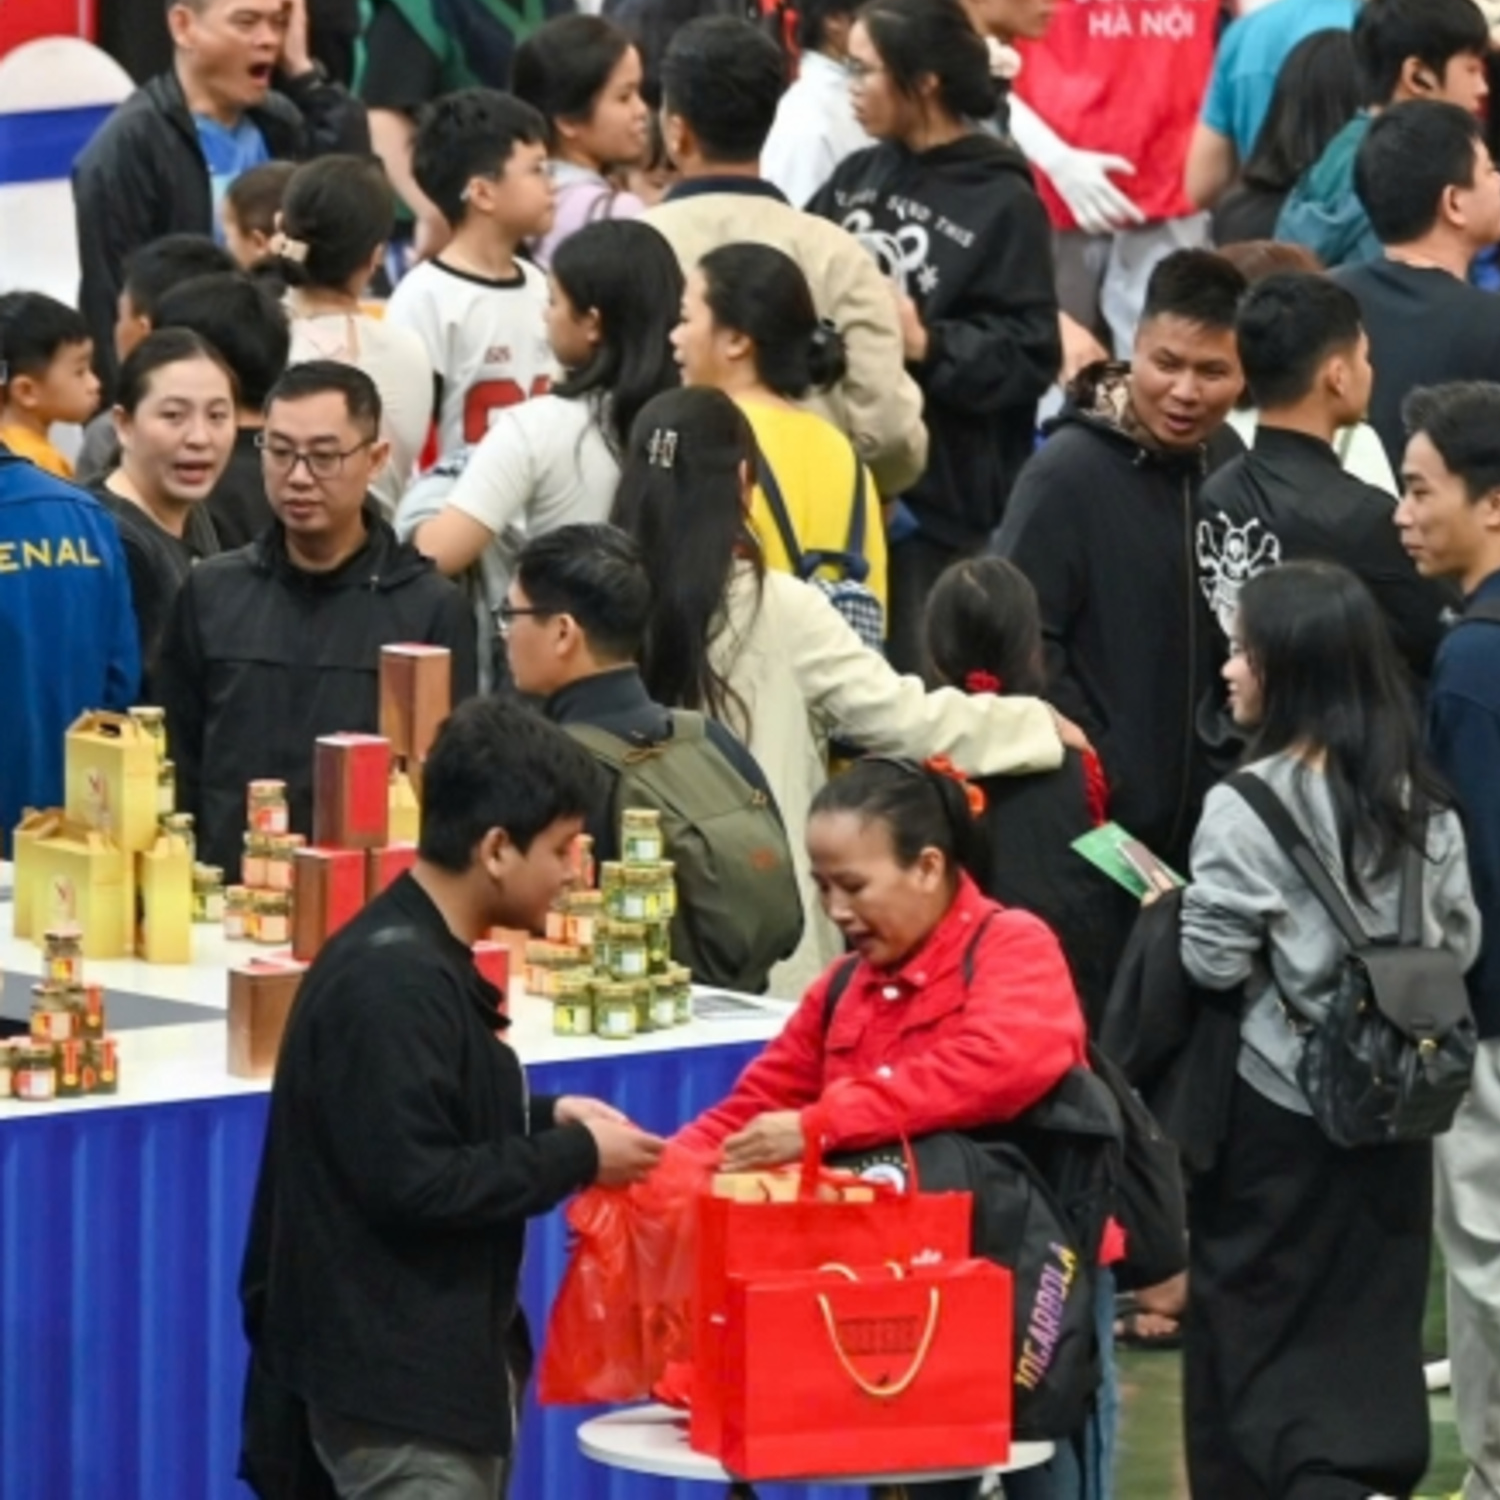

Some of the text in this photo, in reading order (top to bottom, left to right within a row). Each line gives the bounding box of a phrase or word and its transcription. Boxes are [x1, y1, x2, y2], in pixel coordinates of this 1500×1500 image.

[1088, 3, 1196, 41] HÀ NỘI
[1014, 1241, 1076, 1392] JOGARBOLA
